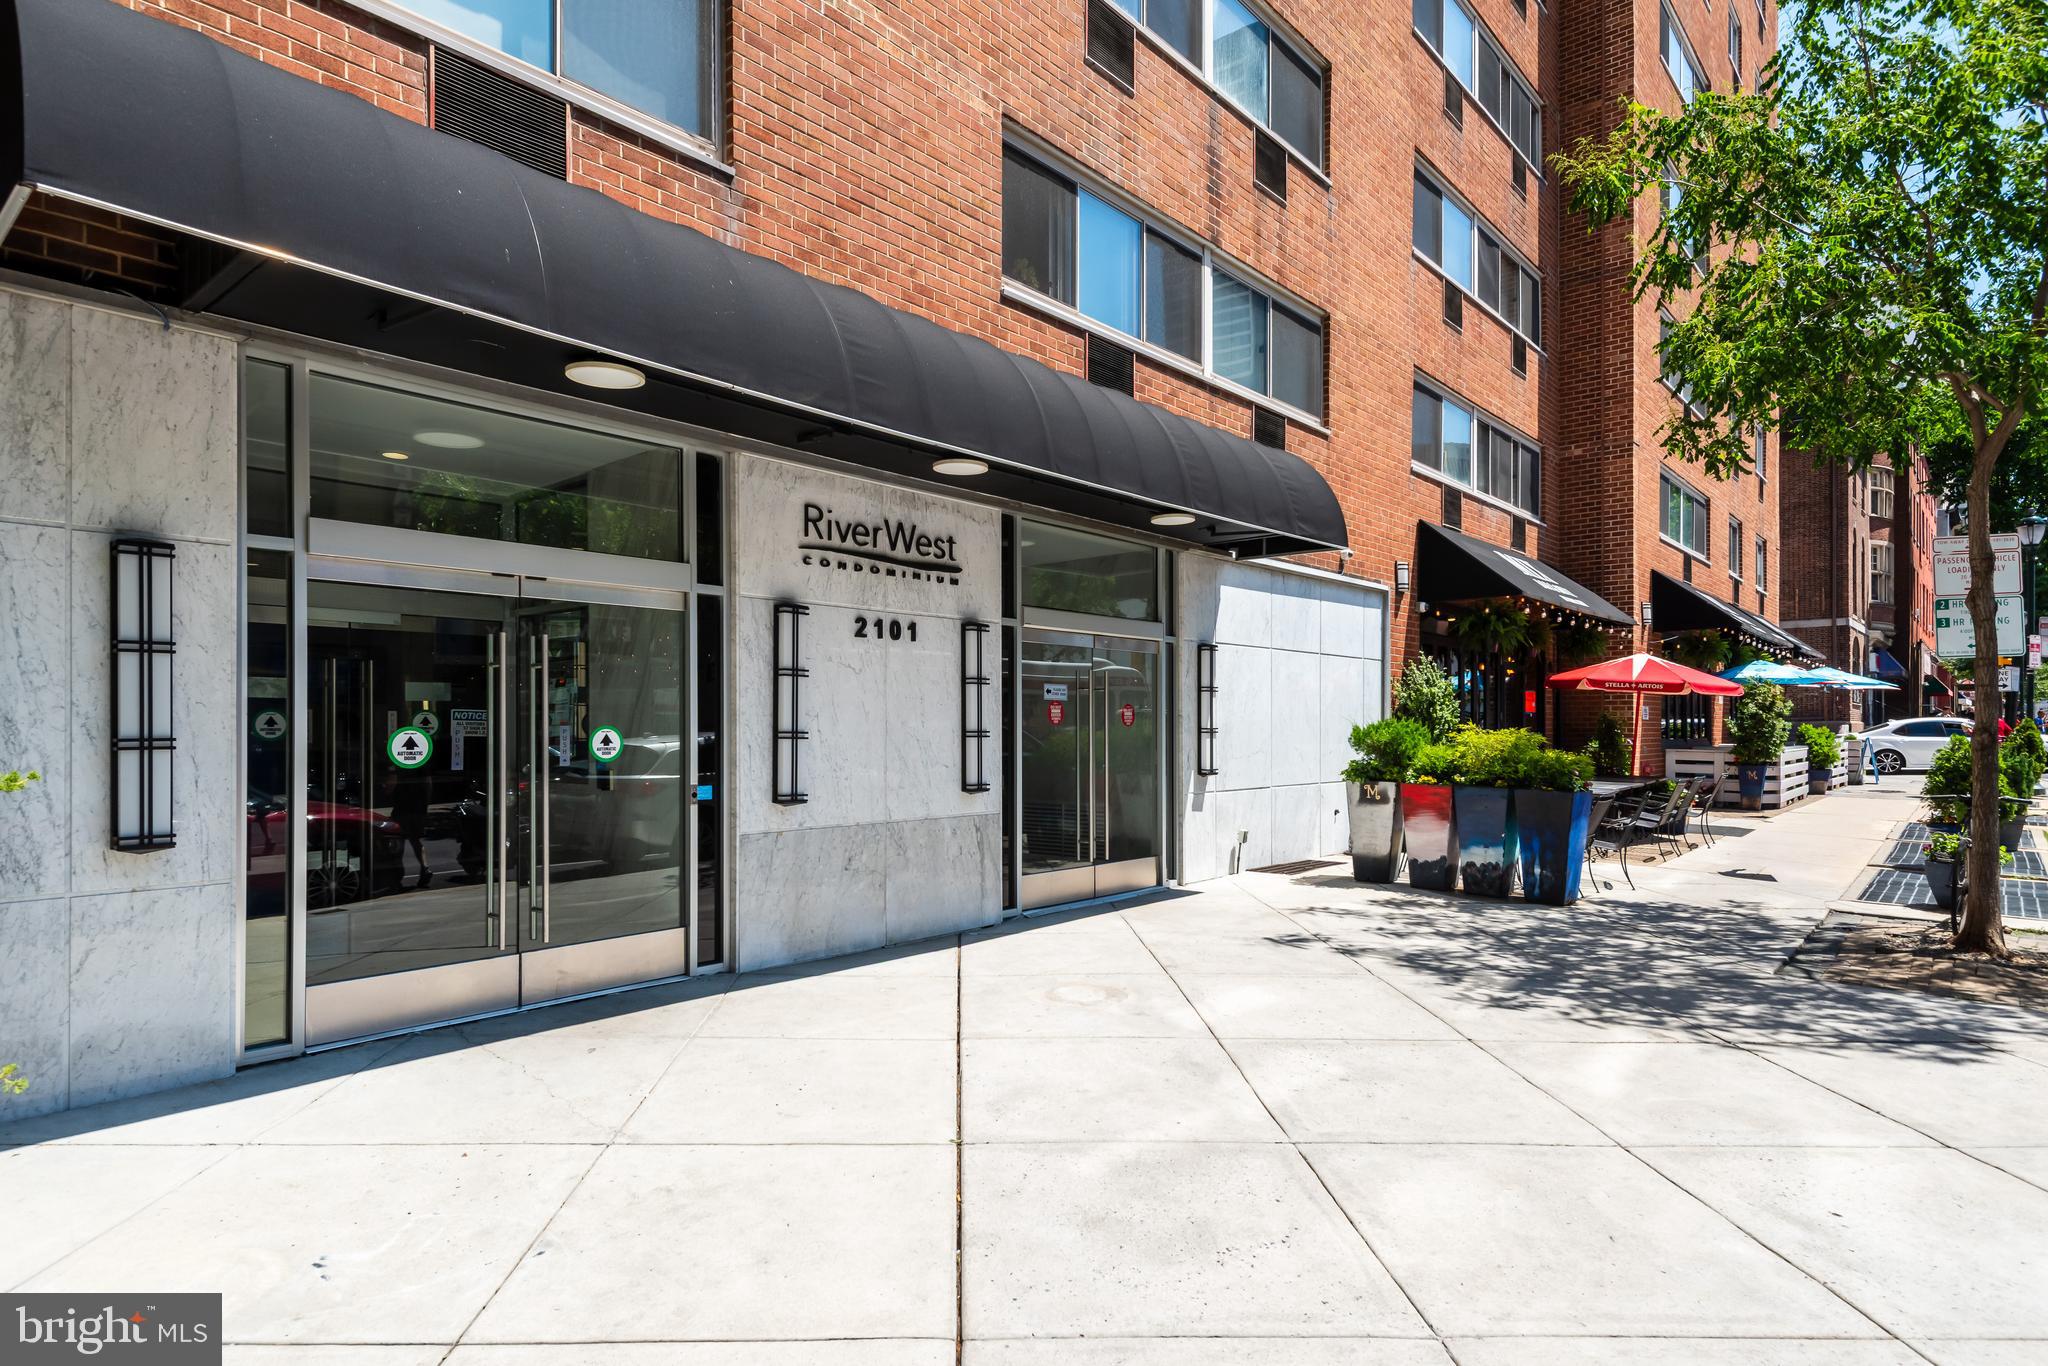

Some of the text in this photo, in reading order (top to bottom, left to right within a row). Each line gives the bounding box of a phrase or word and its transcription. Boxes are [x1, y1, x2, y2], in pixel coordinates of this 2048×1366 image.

[803, 503, 957, 561] RiverWest
[802, 555, 960, 586] CONDOMINIUM
[854, 617, 917, 642] 2101
[1953, 618, 1965, 626] HR
